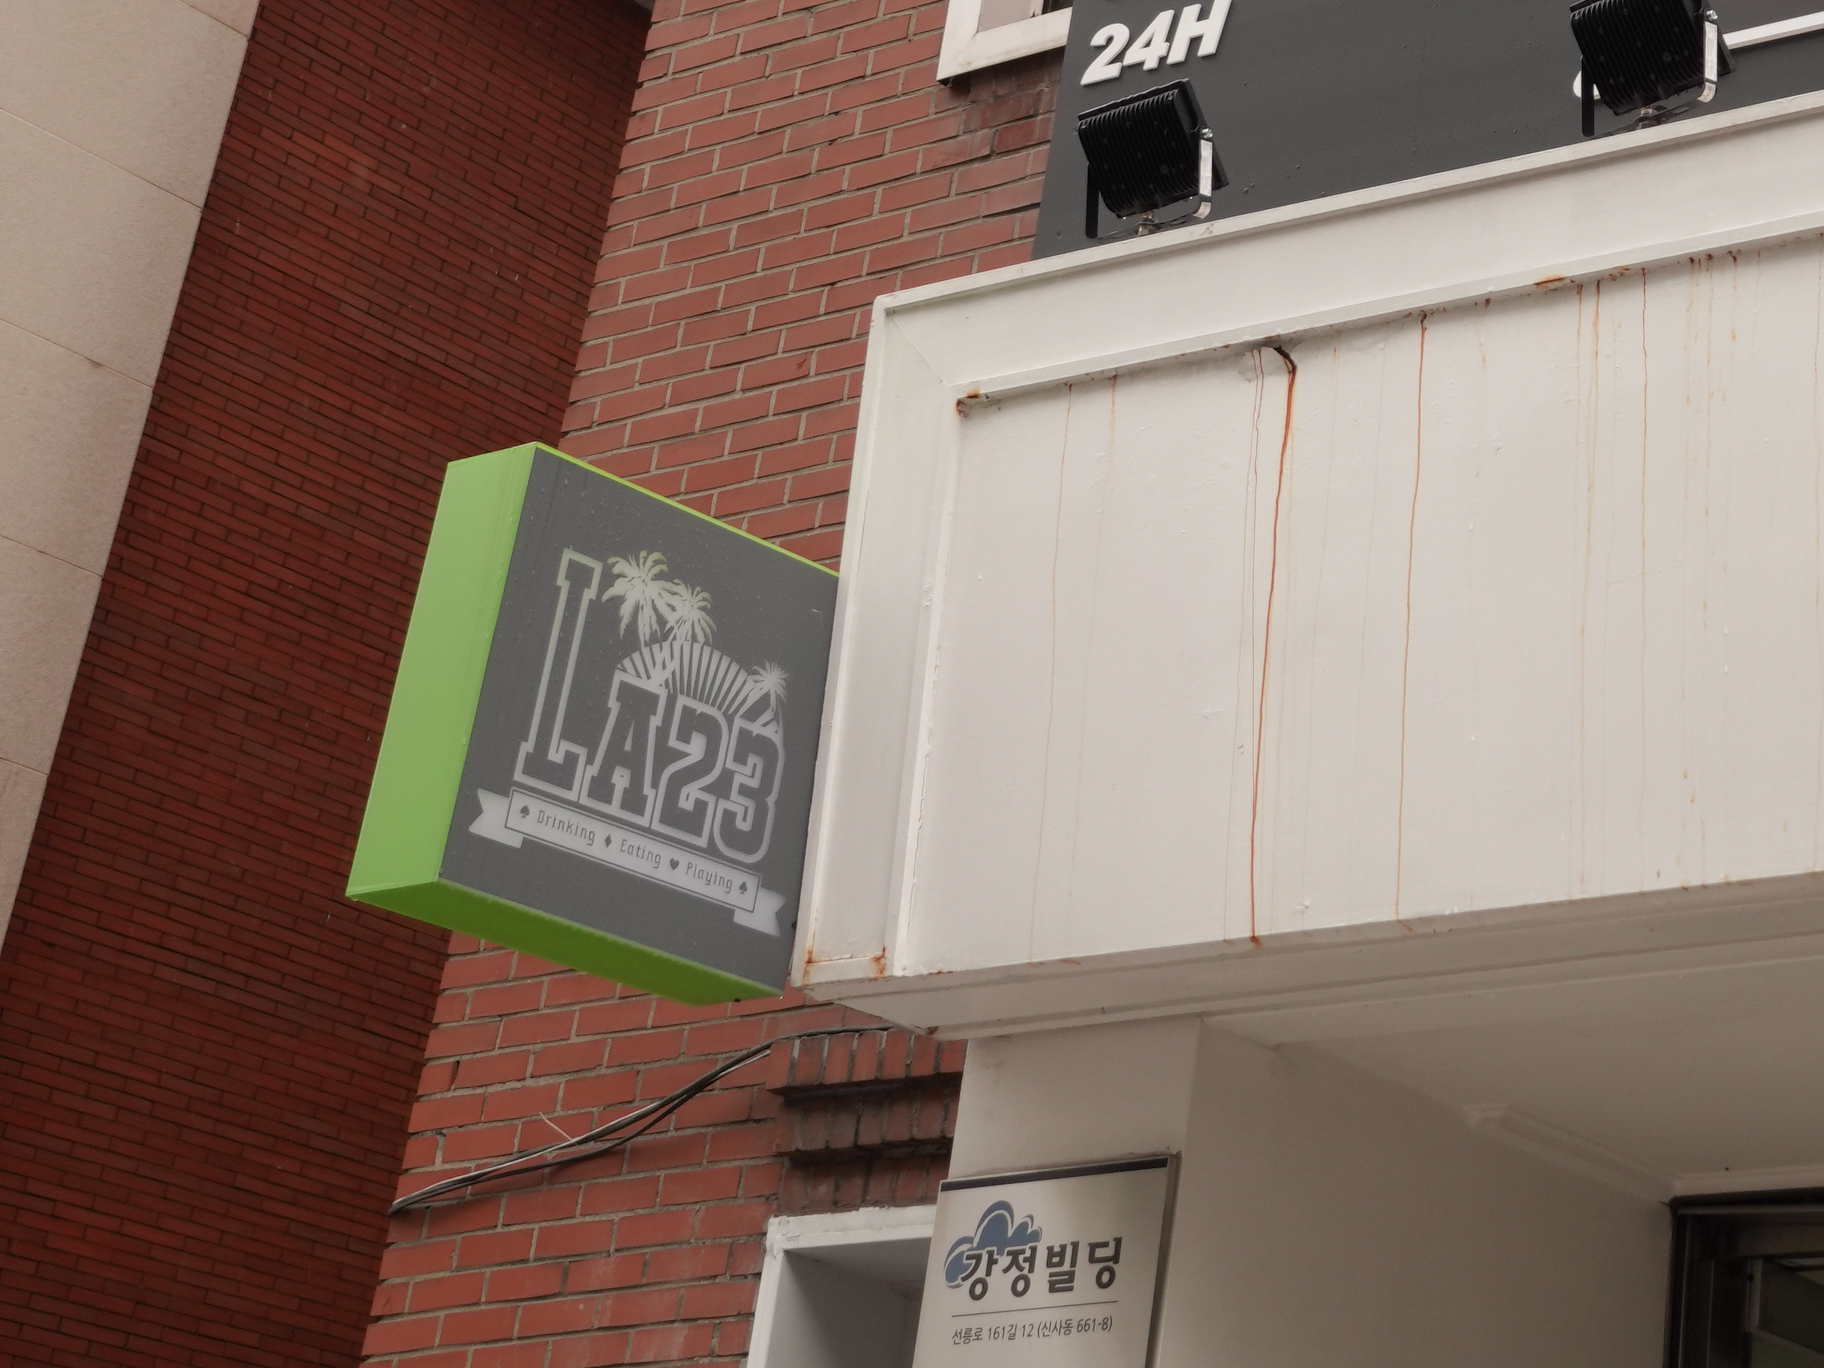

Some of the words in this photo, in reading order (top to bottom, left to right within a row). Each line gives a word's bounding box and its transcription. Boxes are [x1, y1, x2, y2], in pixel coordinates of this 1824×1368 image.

[513, 547, 785, 864] LA23
[537, 809, 596, 846] Drinking
[620, 838, 662, 869] Eating
[686, 861, 733, 894] Playing
[961, 1237, 1123, 1301] 강정빌딩
[952, 1326, 984, 1346] 선릉로
[987, 1323, 1017, 1341] 161길
[1021, 1323, 1034, 1338] 12
[1037, 1317, 1074, 1340] (신사동
[1076, 1315, 1113, 1334] 661-8)
